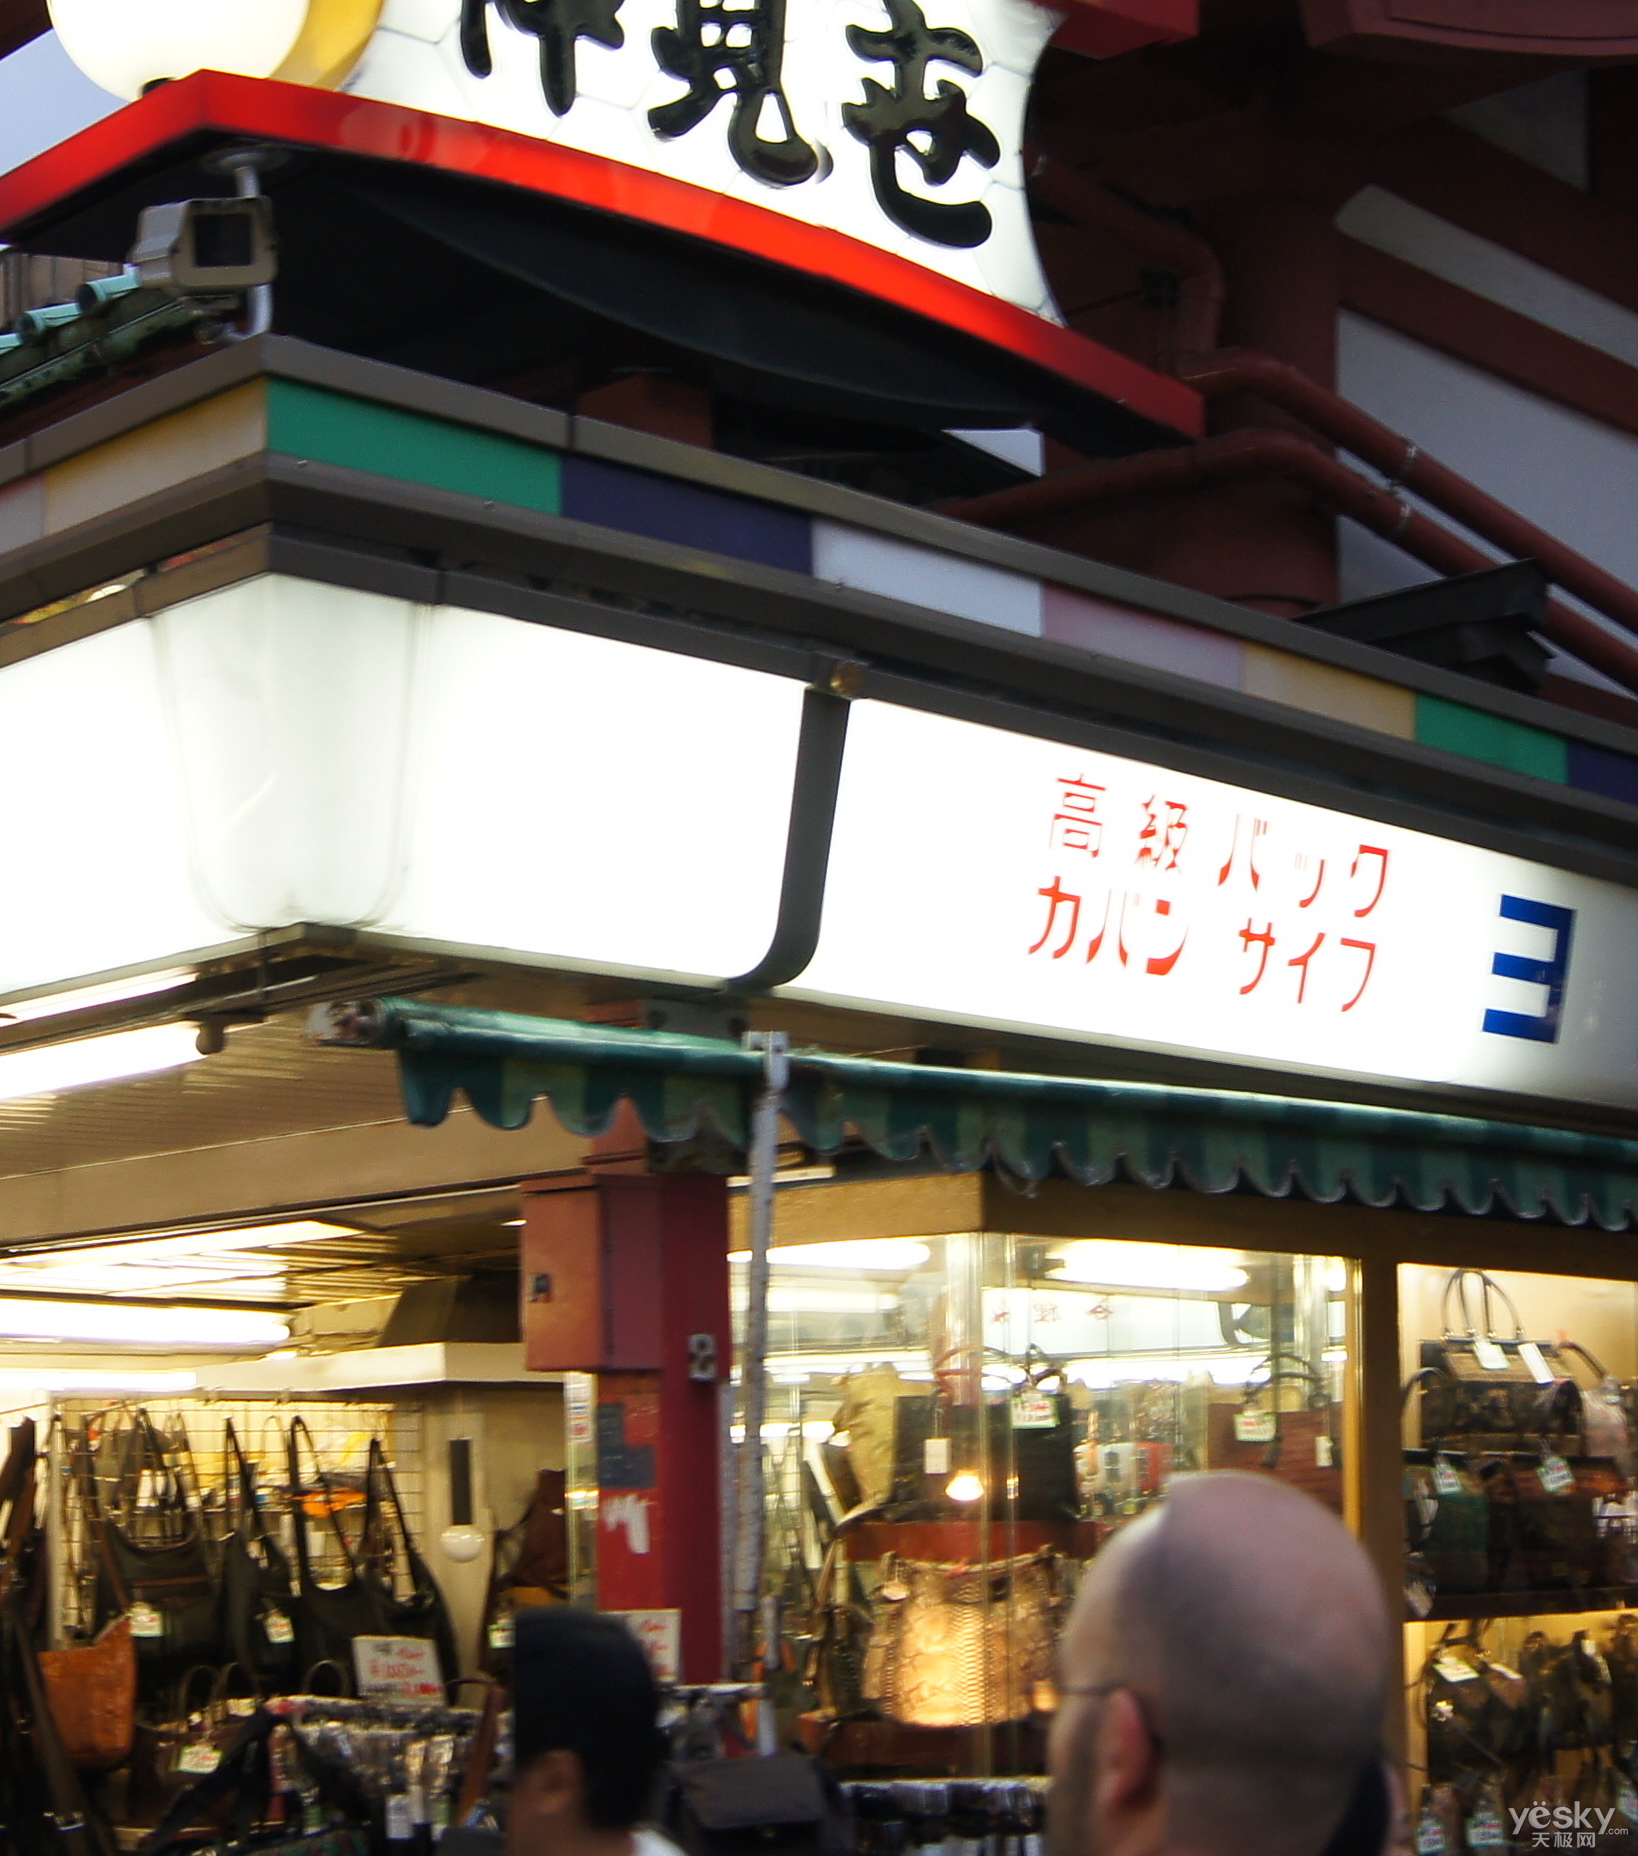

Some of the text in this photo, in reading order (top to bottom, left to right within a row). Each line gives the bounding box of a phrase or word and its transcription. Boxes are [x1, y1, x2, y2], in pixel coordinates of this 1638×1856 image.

[1027, 875, 1378, 1012] カバン サイフ
[1481, 893, 1577, 1045] ヨ
